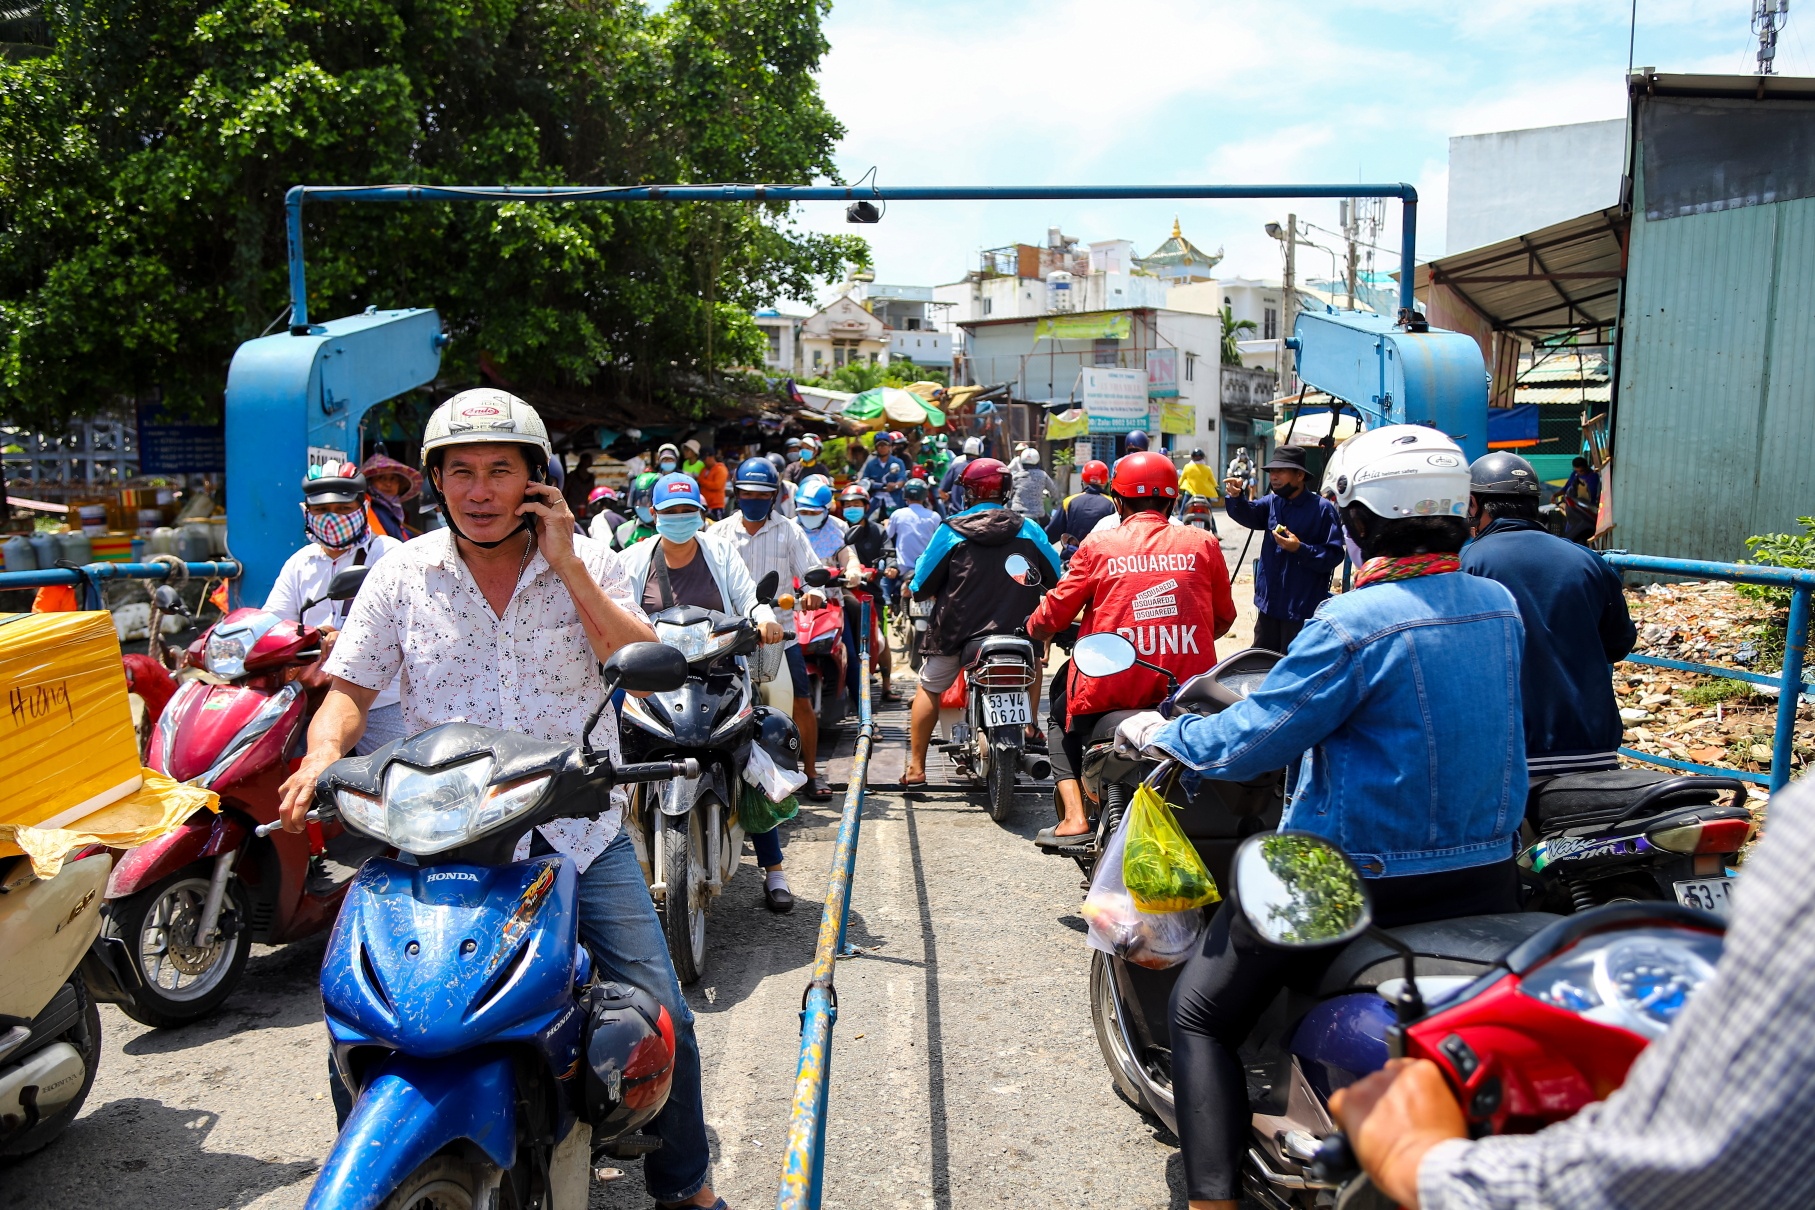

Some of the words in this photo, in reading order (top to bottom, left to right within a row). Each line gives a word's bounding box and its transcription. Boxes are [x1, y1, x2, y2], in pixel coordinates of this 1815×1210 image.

[1148, 358, 1175, 382] IN
[1358, 470, 1380, 481] Asia
[1401, 468, 1418, 476] safety
[1107, 554, 1196, 575] DSQUARED2
[1138, 580, 1176, 600] DSQUARED2
[1133, 595, 1174, 608] DSQUARED2
[1135, 607, 1176, 619] DSQUARED2
[989, 693, 1024, 708] 53-V4
[991, 709, 1026, 724] 0620
[1546, 837, 1597, 860] Wave
[426, 872, 479, 883] HONDA
[546, 1006, 575, 1039] HONDA
[42, 1074, 78, 1094] HONDA
